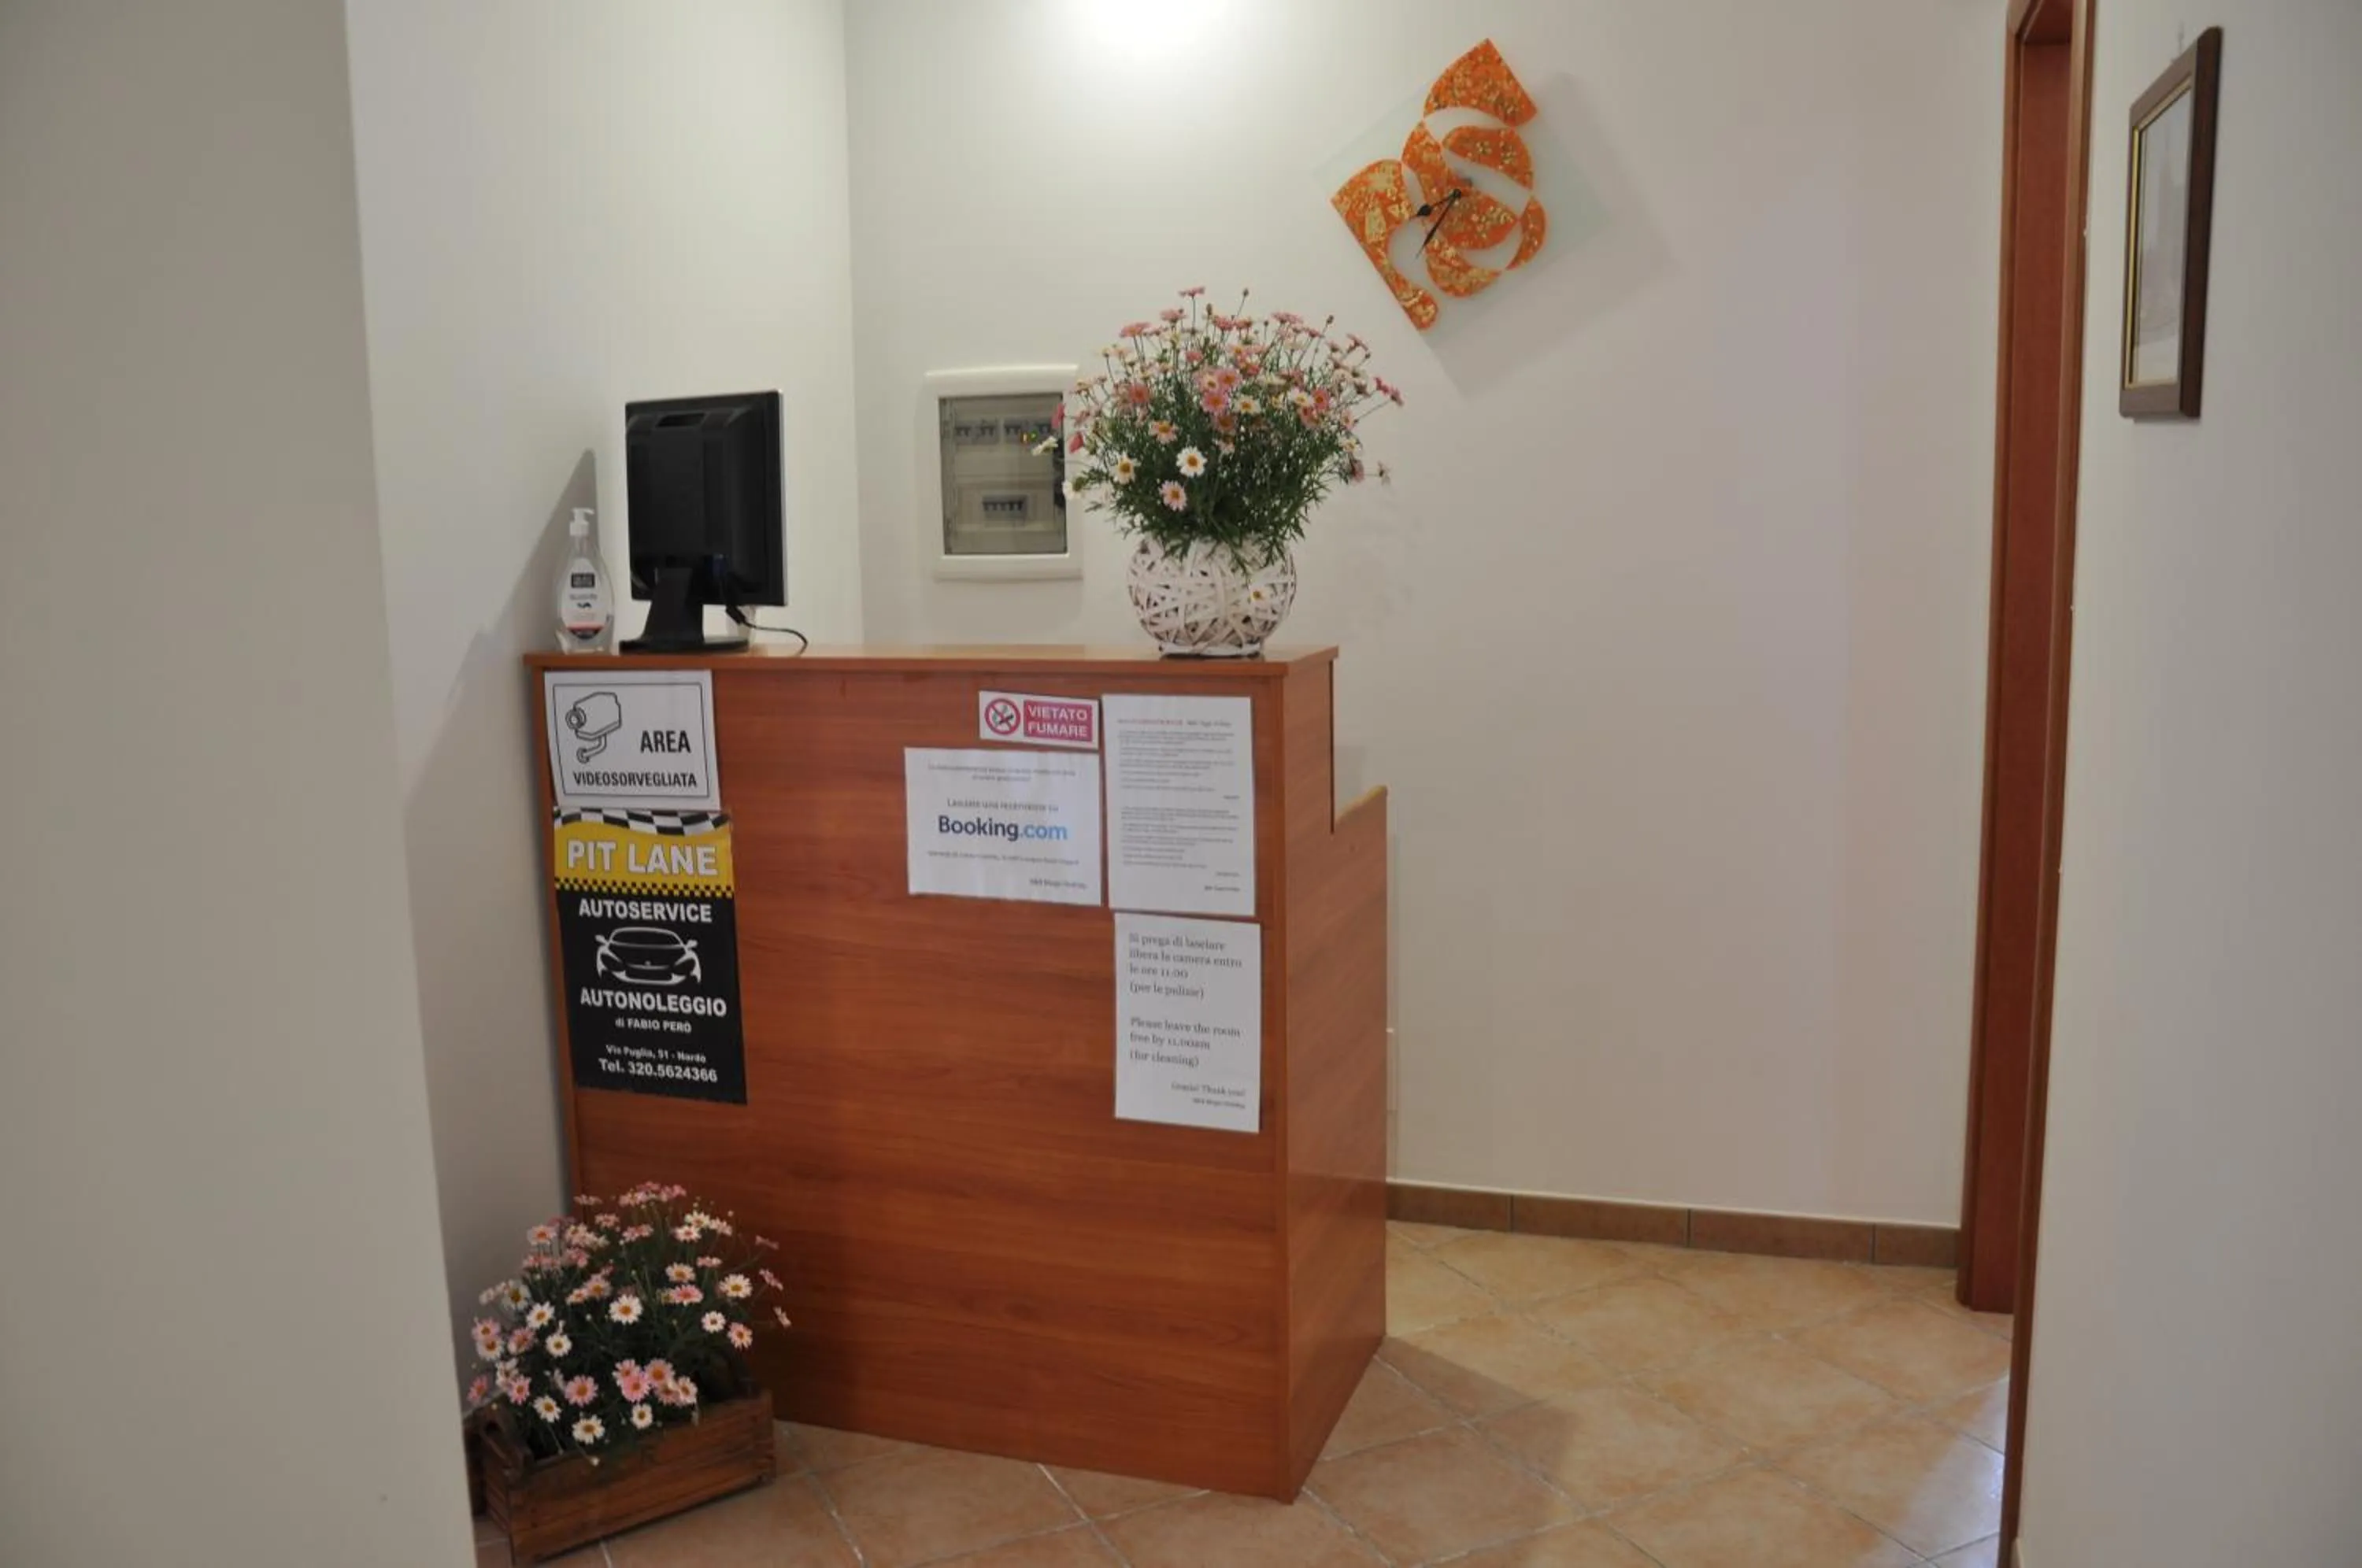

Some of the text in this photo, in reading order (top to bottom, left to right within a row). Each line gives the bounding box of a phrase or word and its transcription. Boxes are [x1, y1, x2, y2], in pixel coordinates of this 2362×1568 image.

[1027, 705, 1087, 721] VIETATO
[1028, 722, 1088, 738] FUMARE
[640, 730, 691, 754] AREA
[573, 771, 698, 788] VIDEOSORVEGLIATA
[939, 814, 1068, 842] Booking.com
[567, 840, 717, 876] PIT LANE
[579, 898, 713, 923] AUTOSERVICE
[1142, 936, 1169, 947] prega
[1172, 935, 1183, 948] di
[1184, 934, 1225, 950] lasciare
[1129, 947, 1158, 960] libera
[1172, 953, 1211, 965] camera
[1213, 956, 1242, 968] entro
[1129, 962, 1139, 975] le
[1141, 966, 1158, 976] ore
[1129, 981, 1151, 995] (per
[1153, 981, 1164, 993] le
[580, 987, 727, 1018] AUTONOLEGGIO
[615, 1016, 624, 1028] di
[628, 1018, 661, 1030] FABIO
[1131, 1016, 1240, 1037] Please leave the room
[1130, 1031, 1150, 1043] free
[1152, 1033, 1165, 1047] by
[605, 1045, 621, 1055] Via
[624, 1046, 656, 1060] Puglia,
[1151, 1051, 1199, 1068] cleaning)
[598, 1058, 718, 1083] Tel. 320.5624366
